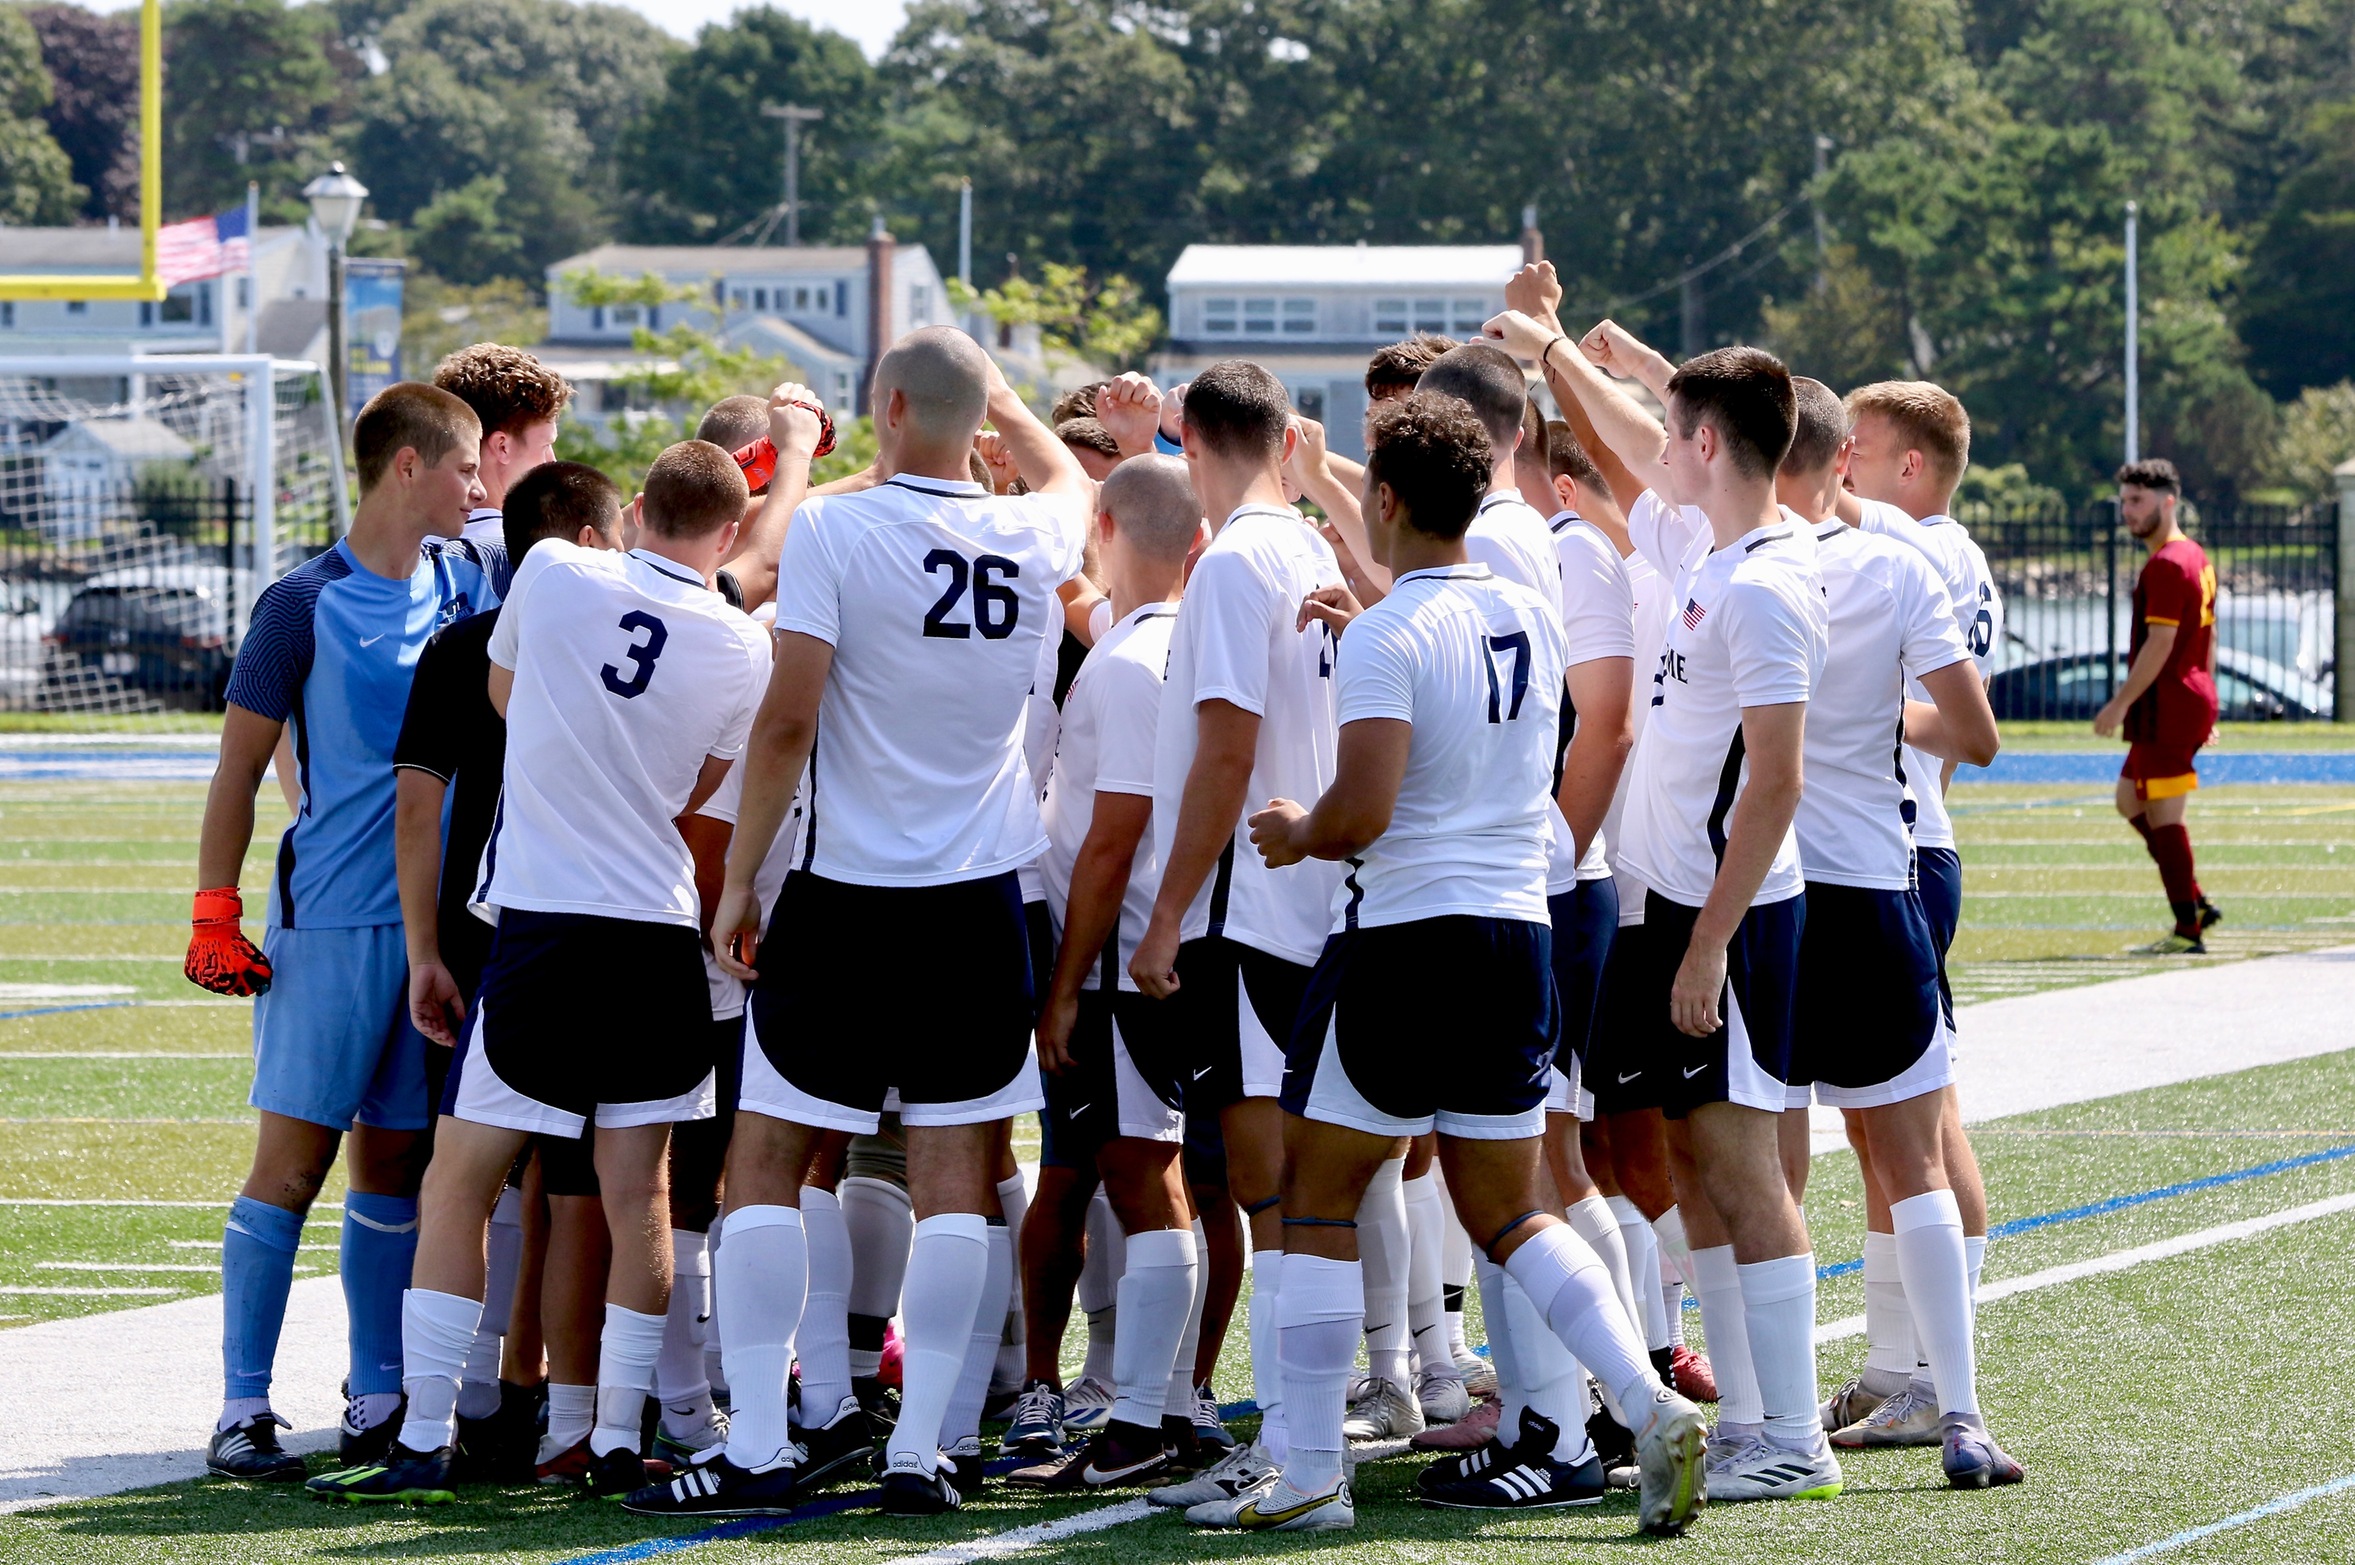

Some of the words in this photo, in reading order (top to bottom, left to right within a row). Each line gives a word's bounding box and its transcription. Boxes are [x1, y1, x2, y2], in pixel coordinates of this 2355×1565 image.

[922, 549, 1020, 640] 26
[600, 609, 669, 700] 3
[1480, 630, 1532, 724] 17
[892, 1461, 918, 1469] adidas
